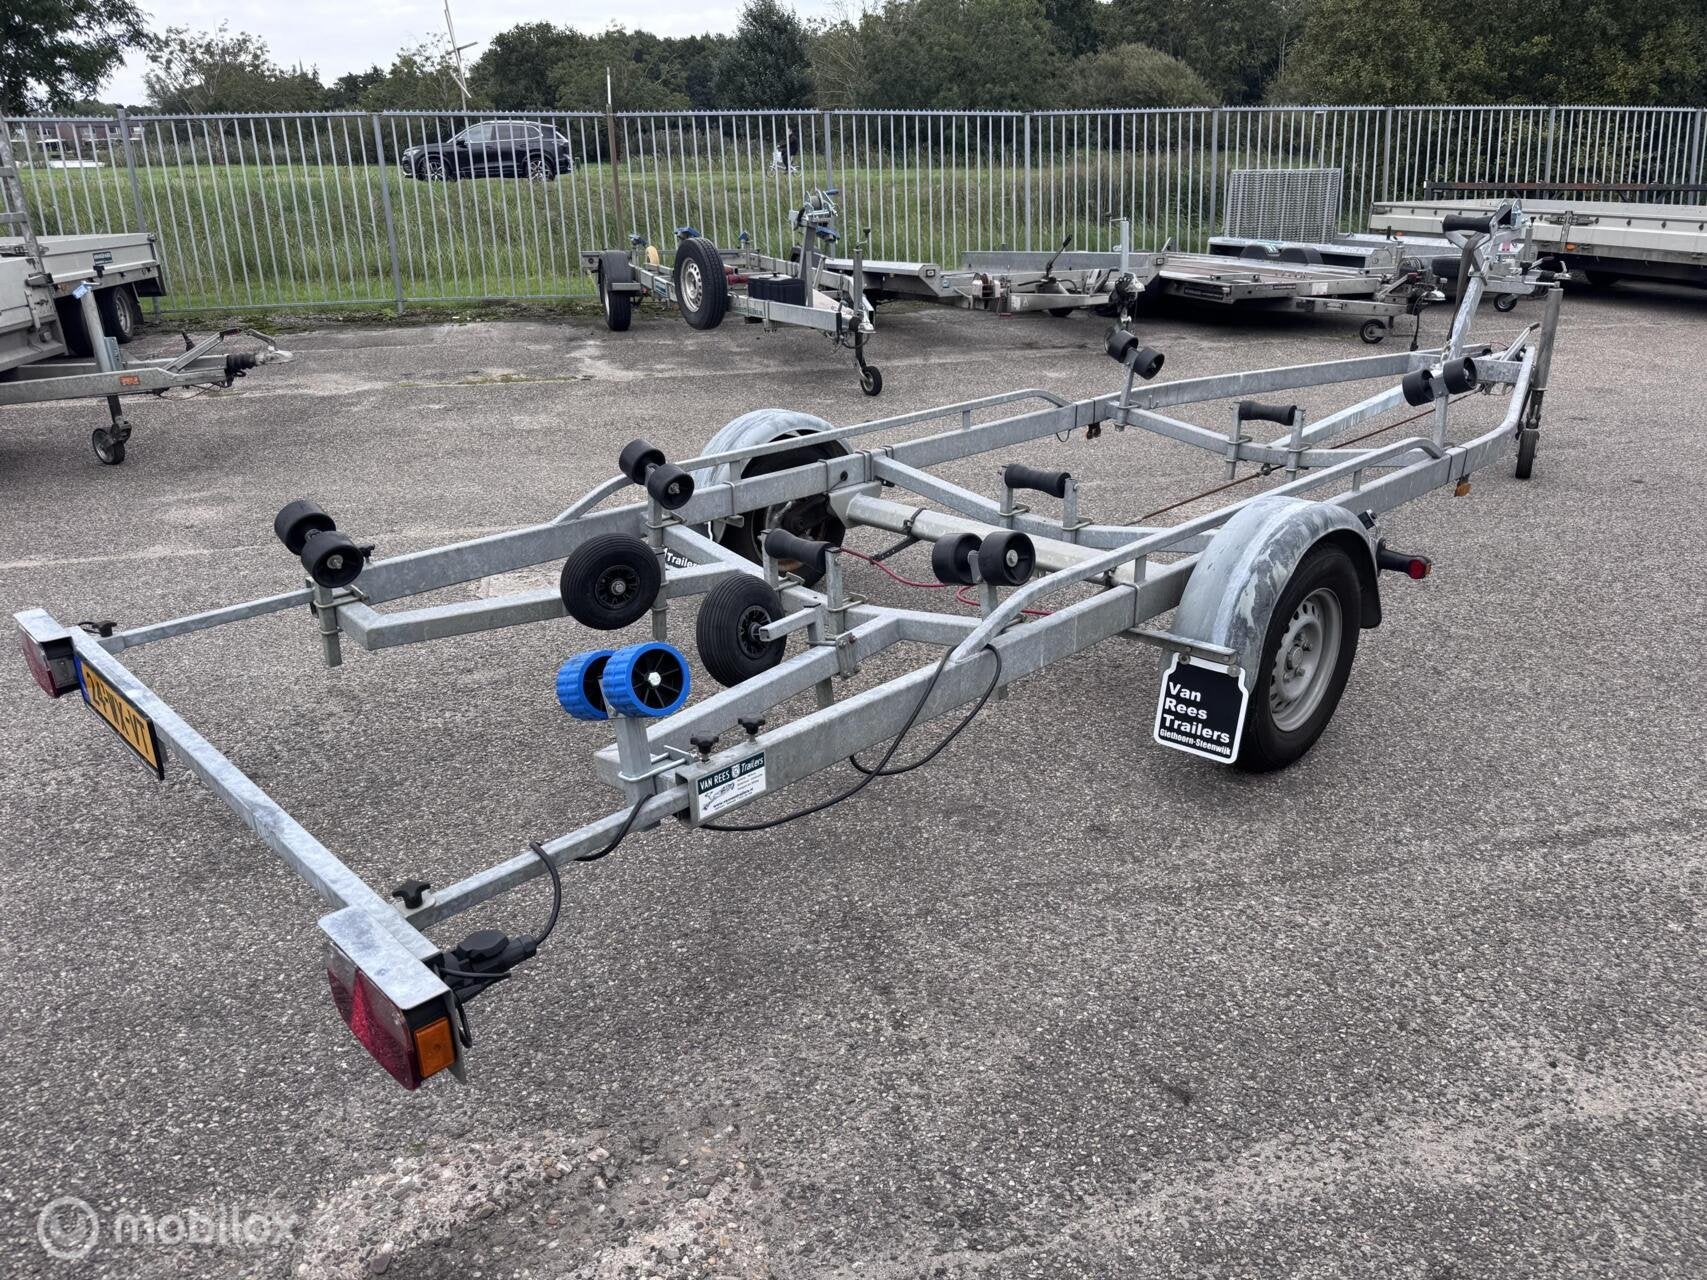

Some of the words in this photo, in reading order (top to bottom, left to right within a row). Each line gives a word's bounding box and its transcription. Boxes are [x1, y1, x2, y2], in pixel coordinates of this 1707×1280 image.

[1168, 681, 1202, 702] Van
[1164, 697, 1208, 720] Rees
[1159, 728, 1232, 756] Giethoorn-Steenwijk
[1162, 713, 1231, 744] Trailers
[700, 776, 713, 790] VAN
[713, 769, 730, 785] REES
[740, 757, 764, 773] Trailers
